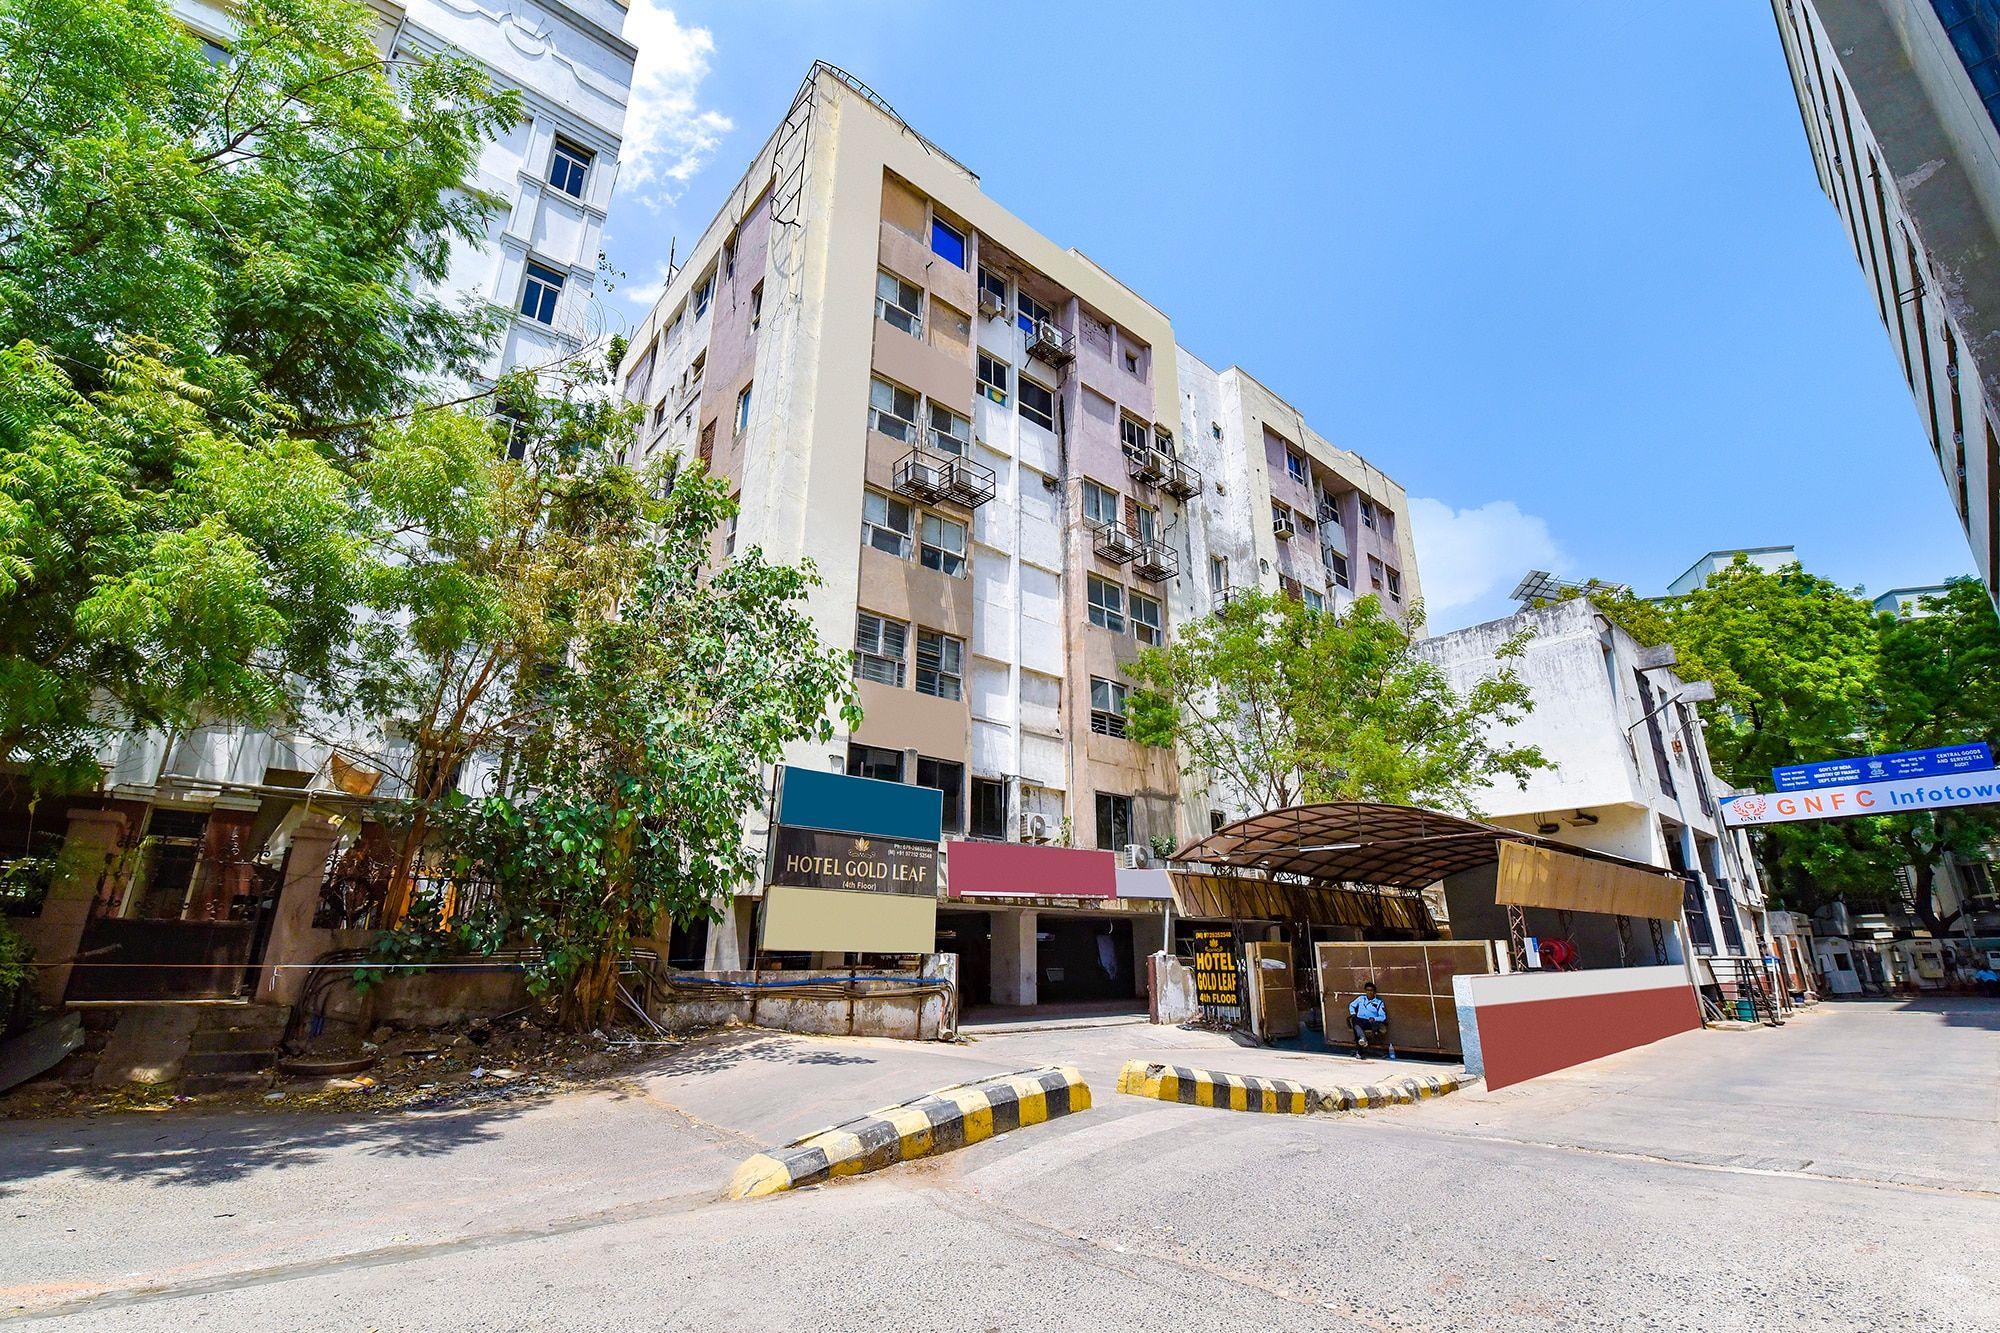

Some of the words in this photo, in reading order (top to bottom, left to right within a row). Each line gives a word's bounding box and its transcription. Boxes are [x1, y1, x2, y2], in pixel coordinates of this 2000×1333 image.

[786, 854, 842, 876] HOTEL
[845, 860, 888, 879] GOLD
[892, 864, 927, 882] LEAF
[842, 881, 856, 889] (4th
[857, 881, 877, 891] Floor)
[1196, 953, 1236, 970] HOTEL
[1197, 972, 1217, 991] GOLD
[1218, 972, 1236, 991] LEAF
[1200, 993, 1211, 1003] 4th
[1212, 993, 1237, 1004] FLOOR
